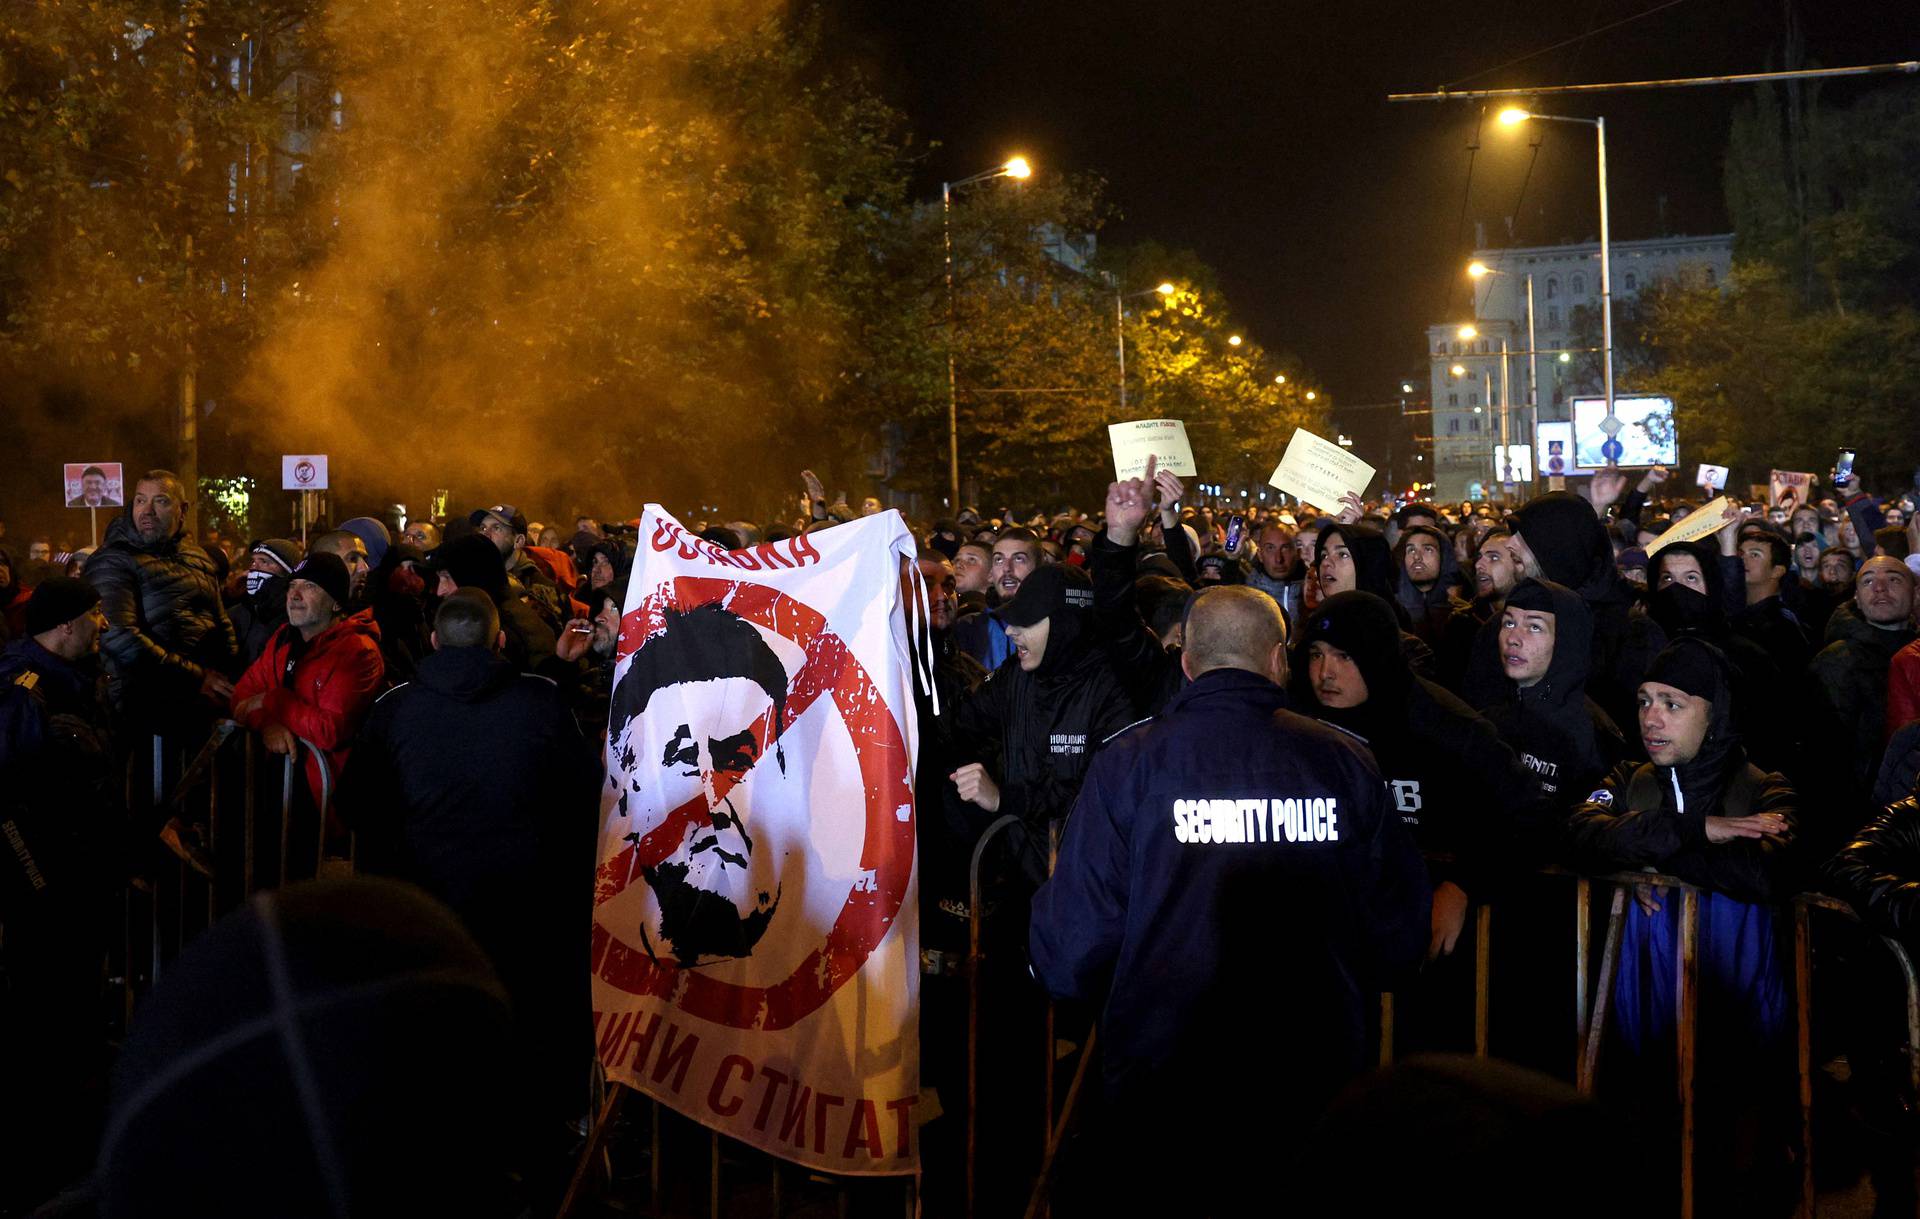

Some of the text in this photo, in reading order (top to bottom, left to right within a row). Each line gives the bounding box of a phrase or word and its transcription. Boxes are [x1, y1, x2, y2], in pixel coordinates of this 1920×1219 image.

[2, 820, 47, 891] SECURITY POLICE
[1173, 797, 1339, 844] SECURITY POLICE
[707, 1053, 919, 1159] СТИГАТ
